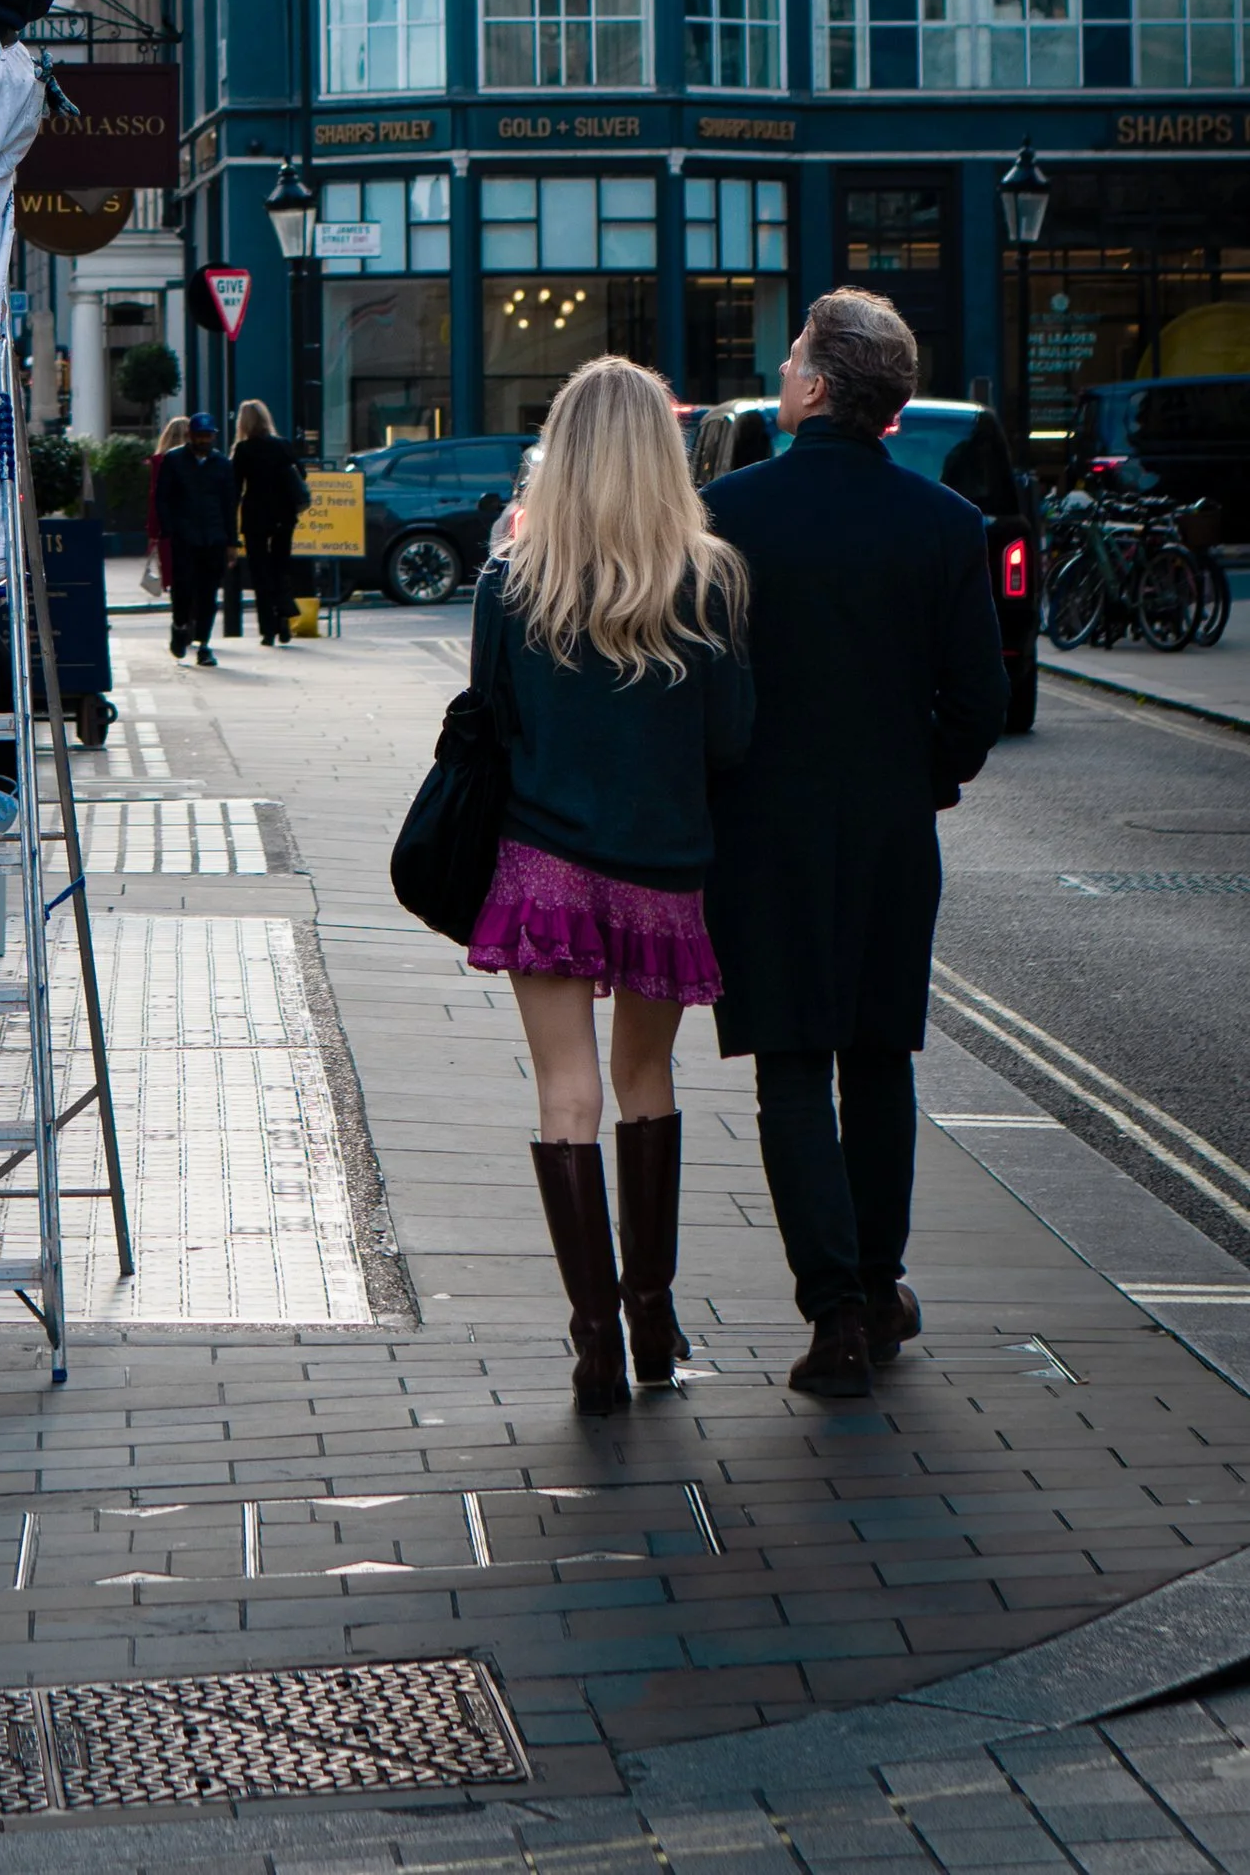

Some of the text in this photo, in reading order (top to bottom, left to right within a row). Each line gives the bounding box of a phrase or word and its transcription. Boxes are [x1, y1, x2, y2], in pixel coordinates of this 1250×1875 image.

[315, 119, 432, 145] SHARPS PIXLEY
[499, 117, 552, 138] GOLD
[574, 116, 640, 138] SILVER
[1117, 114, 1234, 144] SHARPS
[217, 279, 244, 294] GIVE
